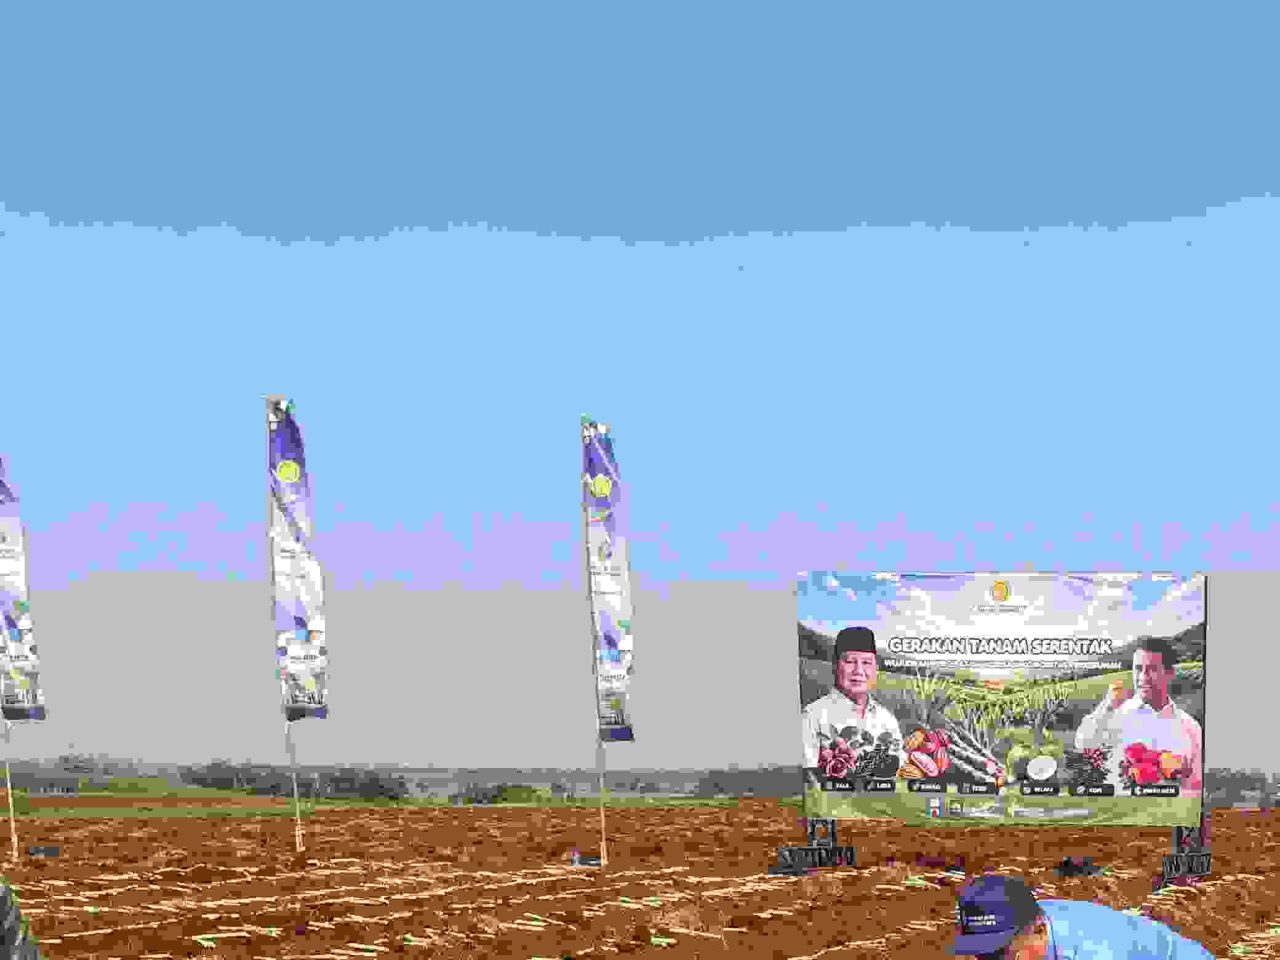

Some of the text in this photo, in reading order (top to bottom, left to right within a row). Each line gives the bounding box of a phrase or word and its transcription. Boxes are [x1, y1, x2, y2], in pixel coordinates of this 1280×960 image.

[888, 637, 1112, 655] GERAKAN TANAM SERENTAK
